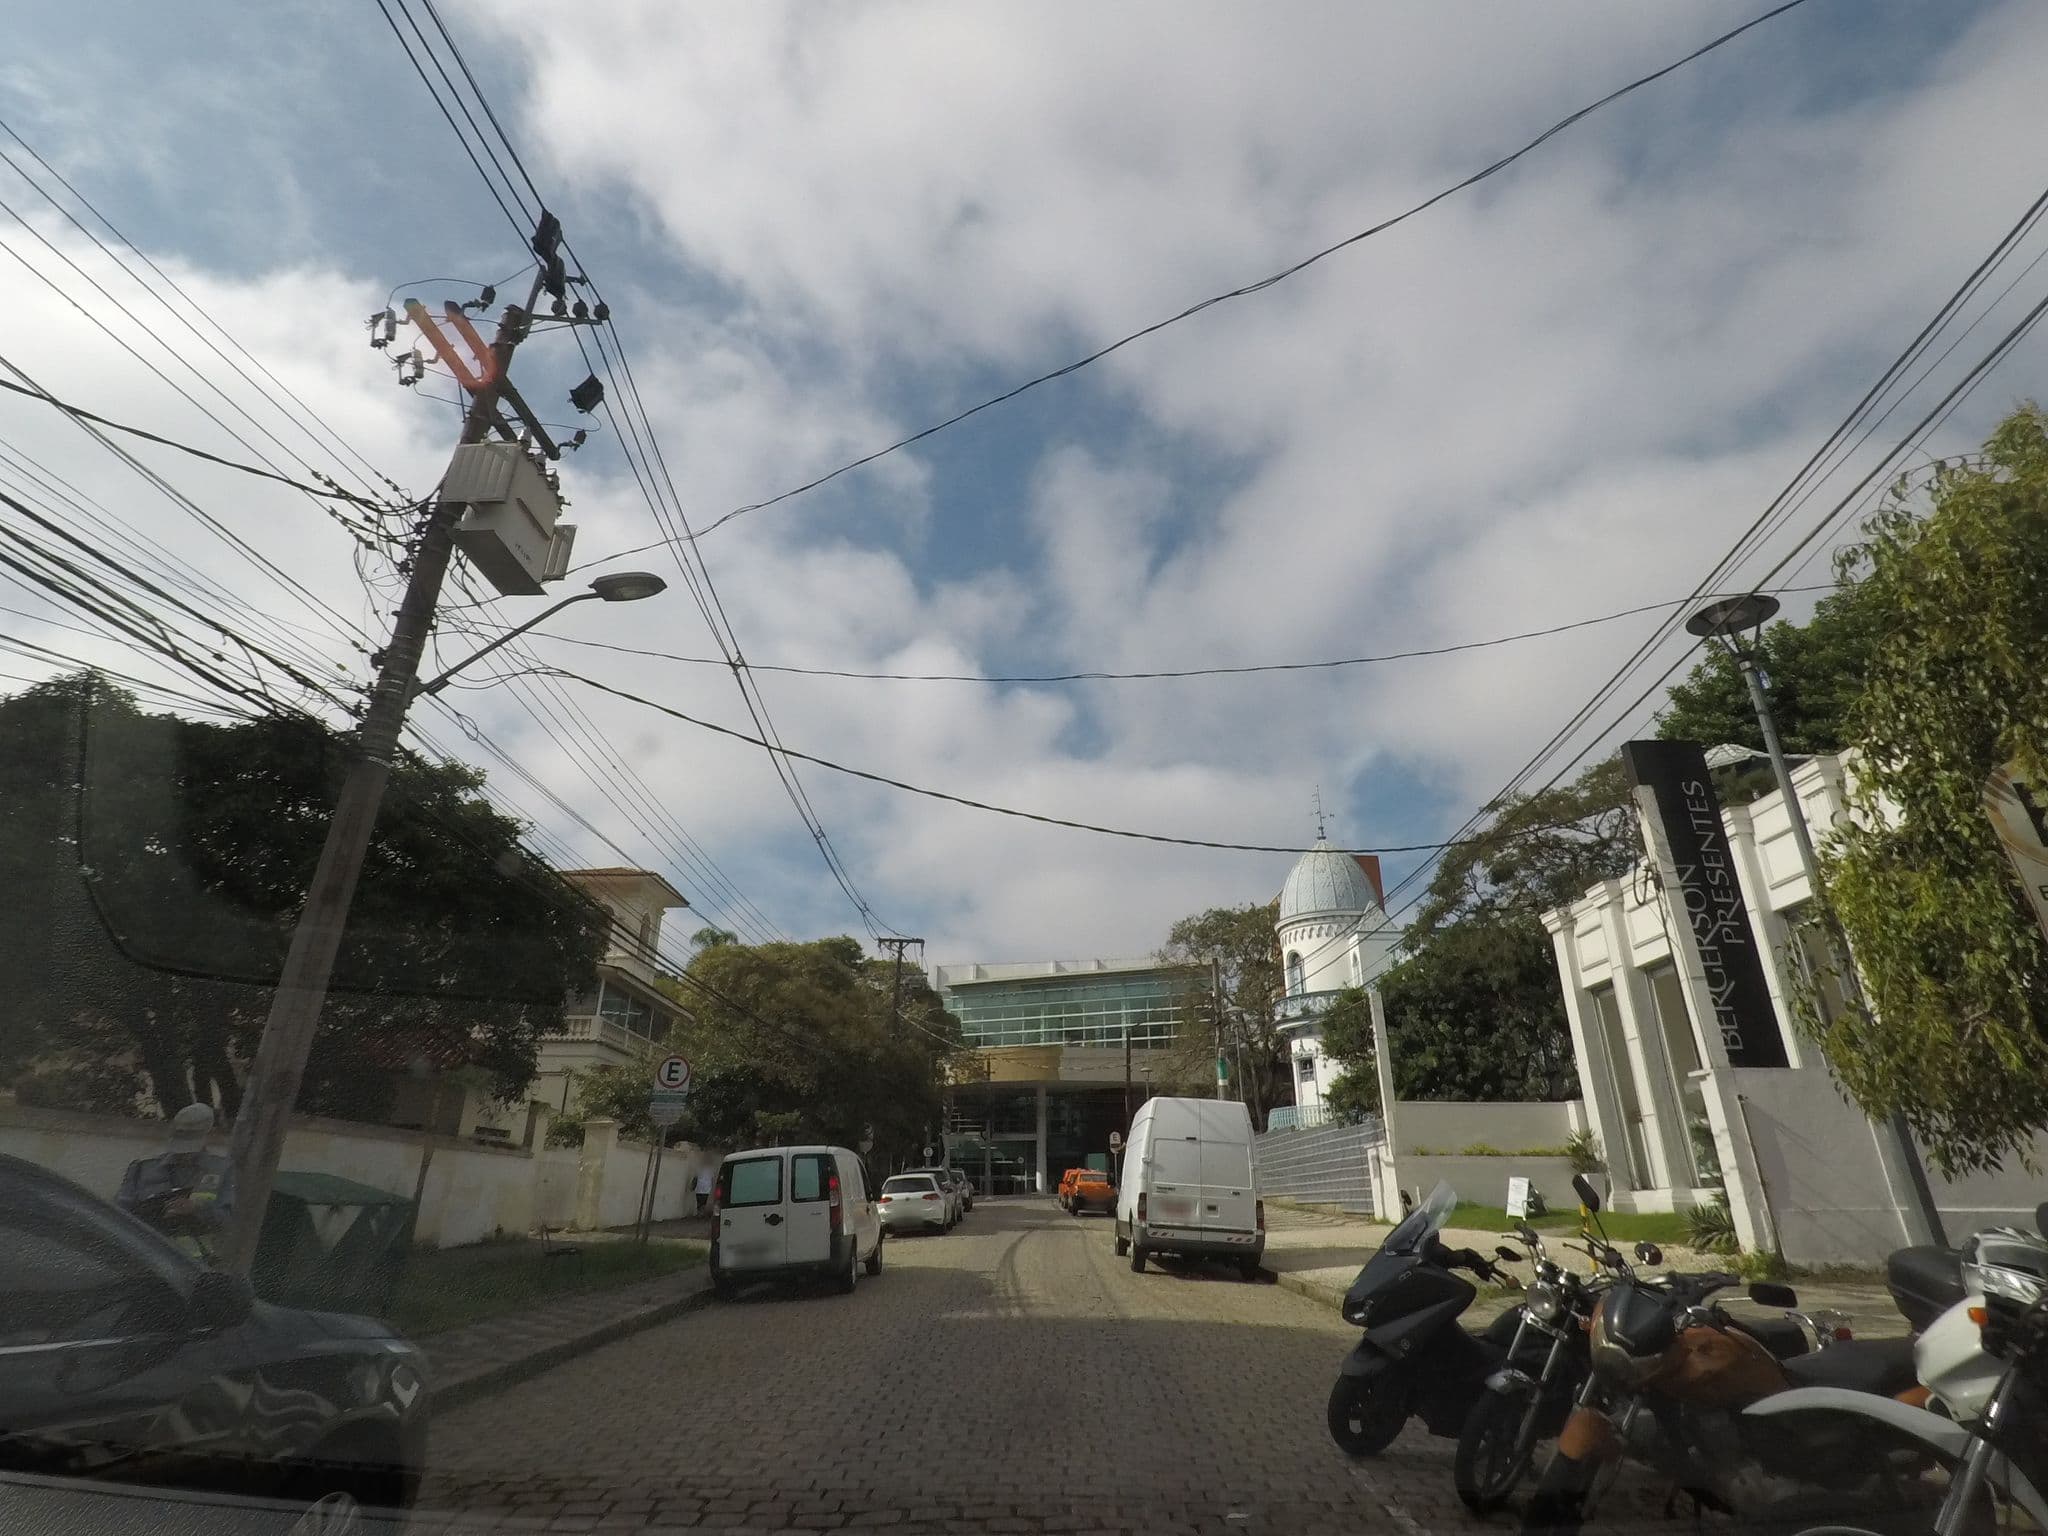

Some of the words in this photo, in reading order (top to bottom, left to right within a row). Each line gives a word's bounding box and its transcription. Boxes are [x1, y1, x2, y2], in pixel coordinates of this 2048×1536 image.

[1682, 779, 1745, 943] PRESENTES
[1681, 864, 1743, 1050] BERGERSON
[667, 1061, 681, 1081] E
